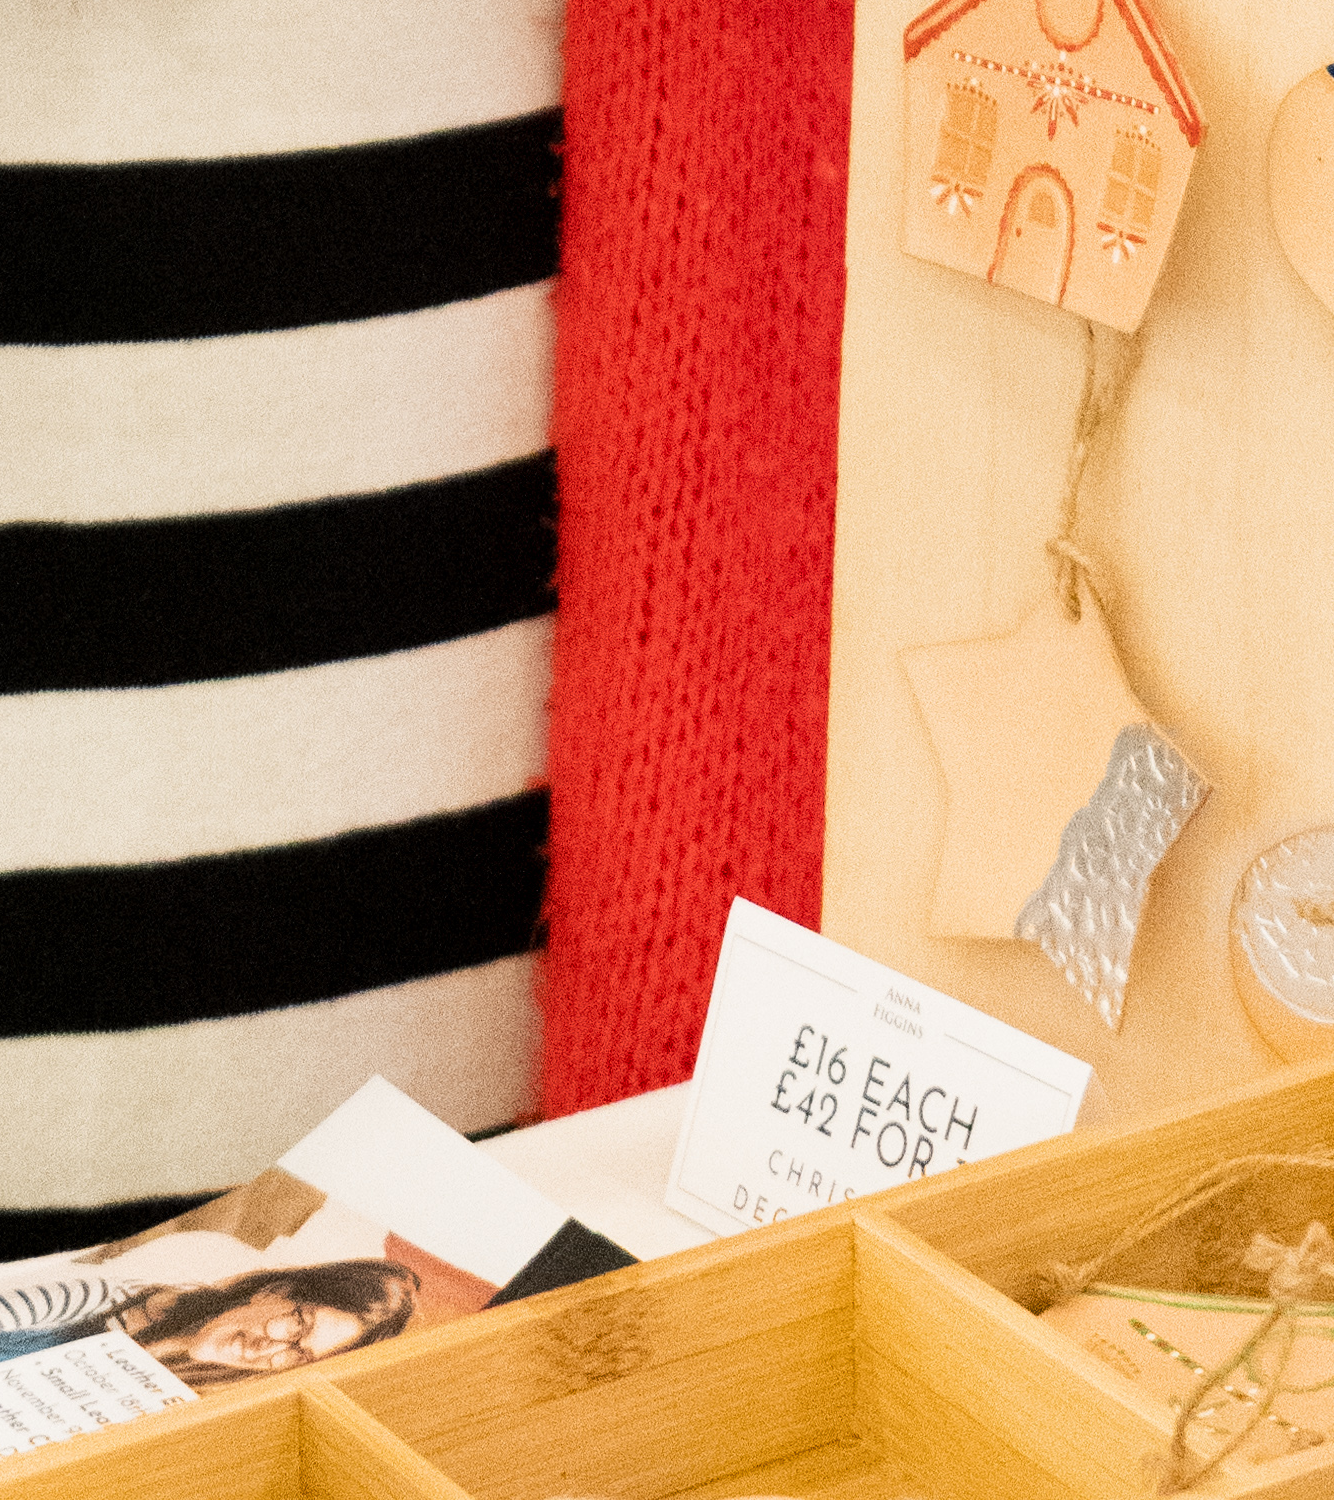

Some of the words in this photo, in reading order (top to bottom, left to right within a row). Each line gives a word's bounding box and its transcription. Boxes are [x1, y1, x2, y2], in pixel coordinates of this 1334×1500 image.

[873, 1003, 924, 1039] FIGGINS
[885, 986, 921, 1015] ANNA
[789, 1023, 848, 1085] £16
[861, 1055, 979, 1151] EACH
[770, 1070, 839, 1136] £42
[851, 1104, 934, 1179] FOR
[40, 1366, 92, 1400] Small
[63, 1348, 120, 1395] October
[105, 1348, 166, 1395] Leather
